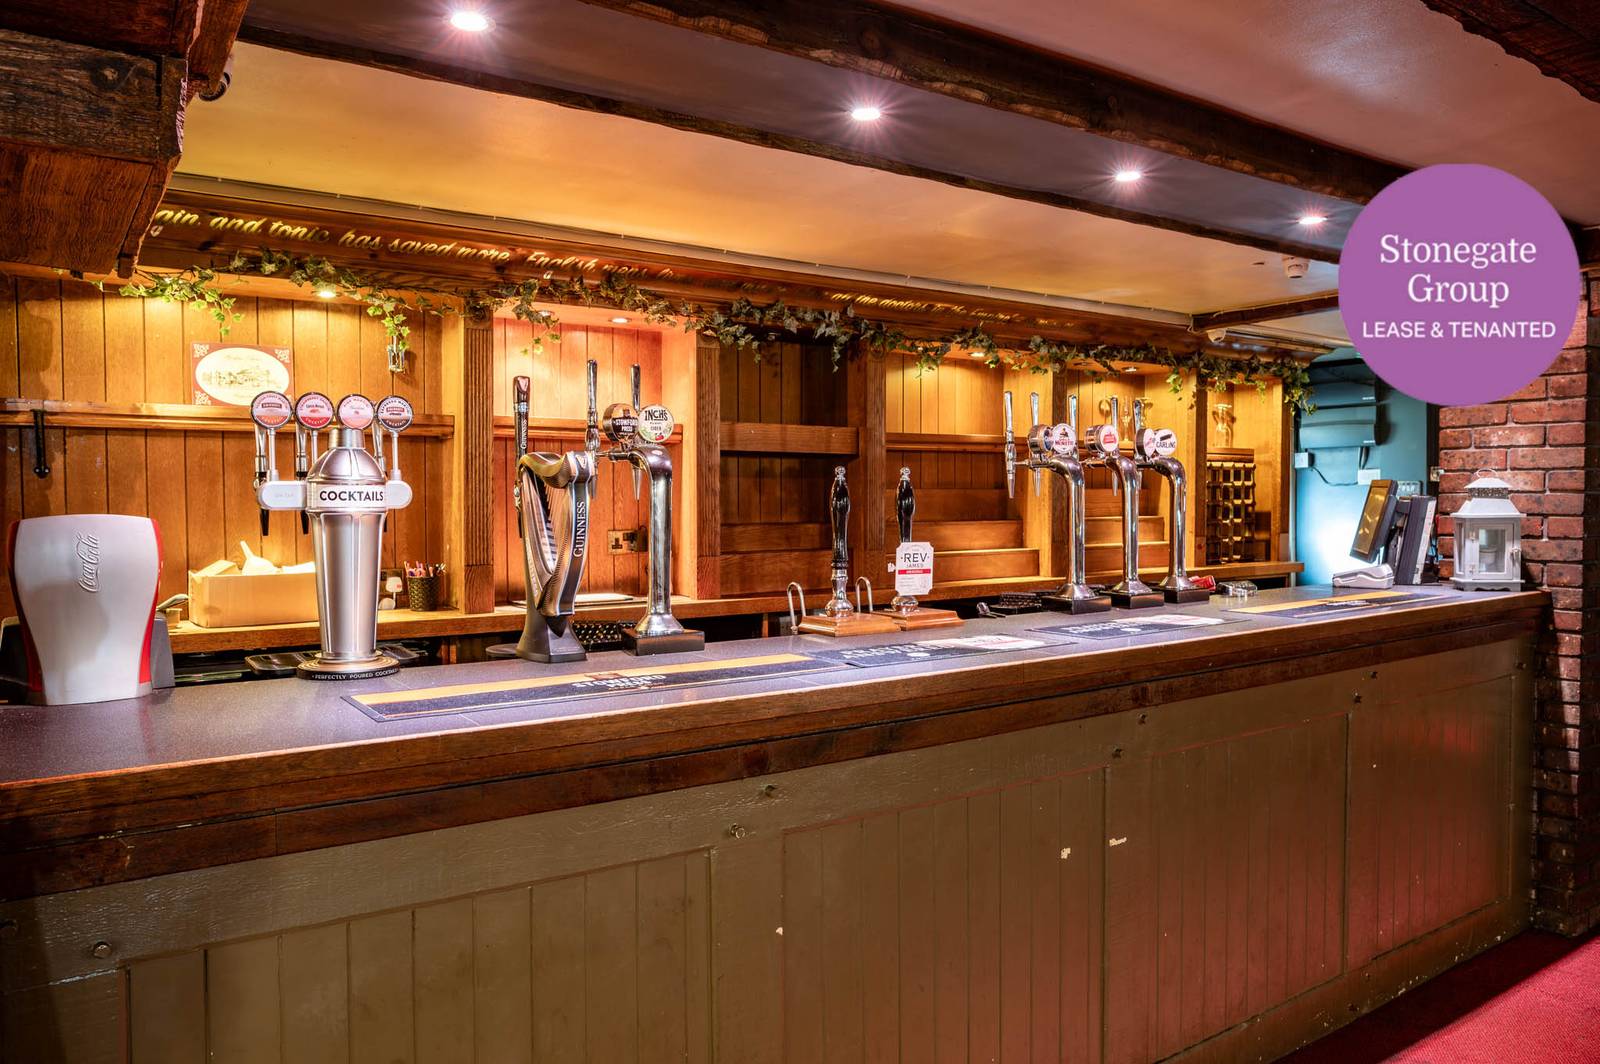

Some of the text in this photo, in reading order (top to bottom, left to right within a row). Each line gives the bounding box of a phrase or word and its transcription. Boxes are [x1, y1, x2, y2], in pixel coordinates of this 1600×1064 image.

[209, 213, 266, 234] and
[268, 219, 330, 242] tonic
[338, 228, 383, 250] has
[388, 236, 457, 257] saved
[456, 245, 511, 262] more
[1156, 440, 1176, 449] CARLING
[319, 490, 384, 501] COCKTAILS
[573, 501, 586, 558] GUINNESS
[904, 553, 927, 563] REV
